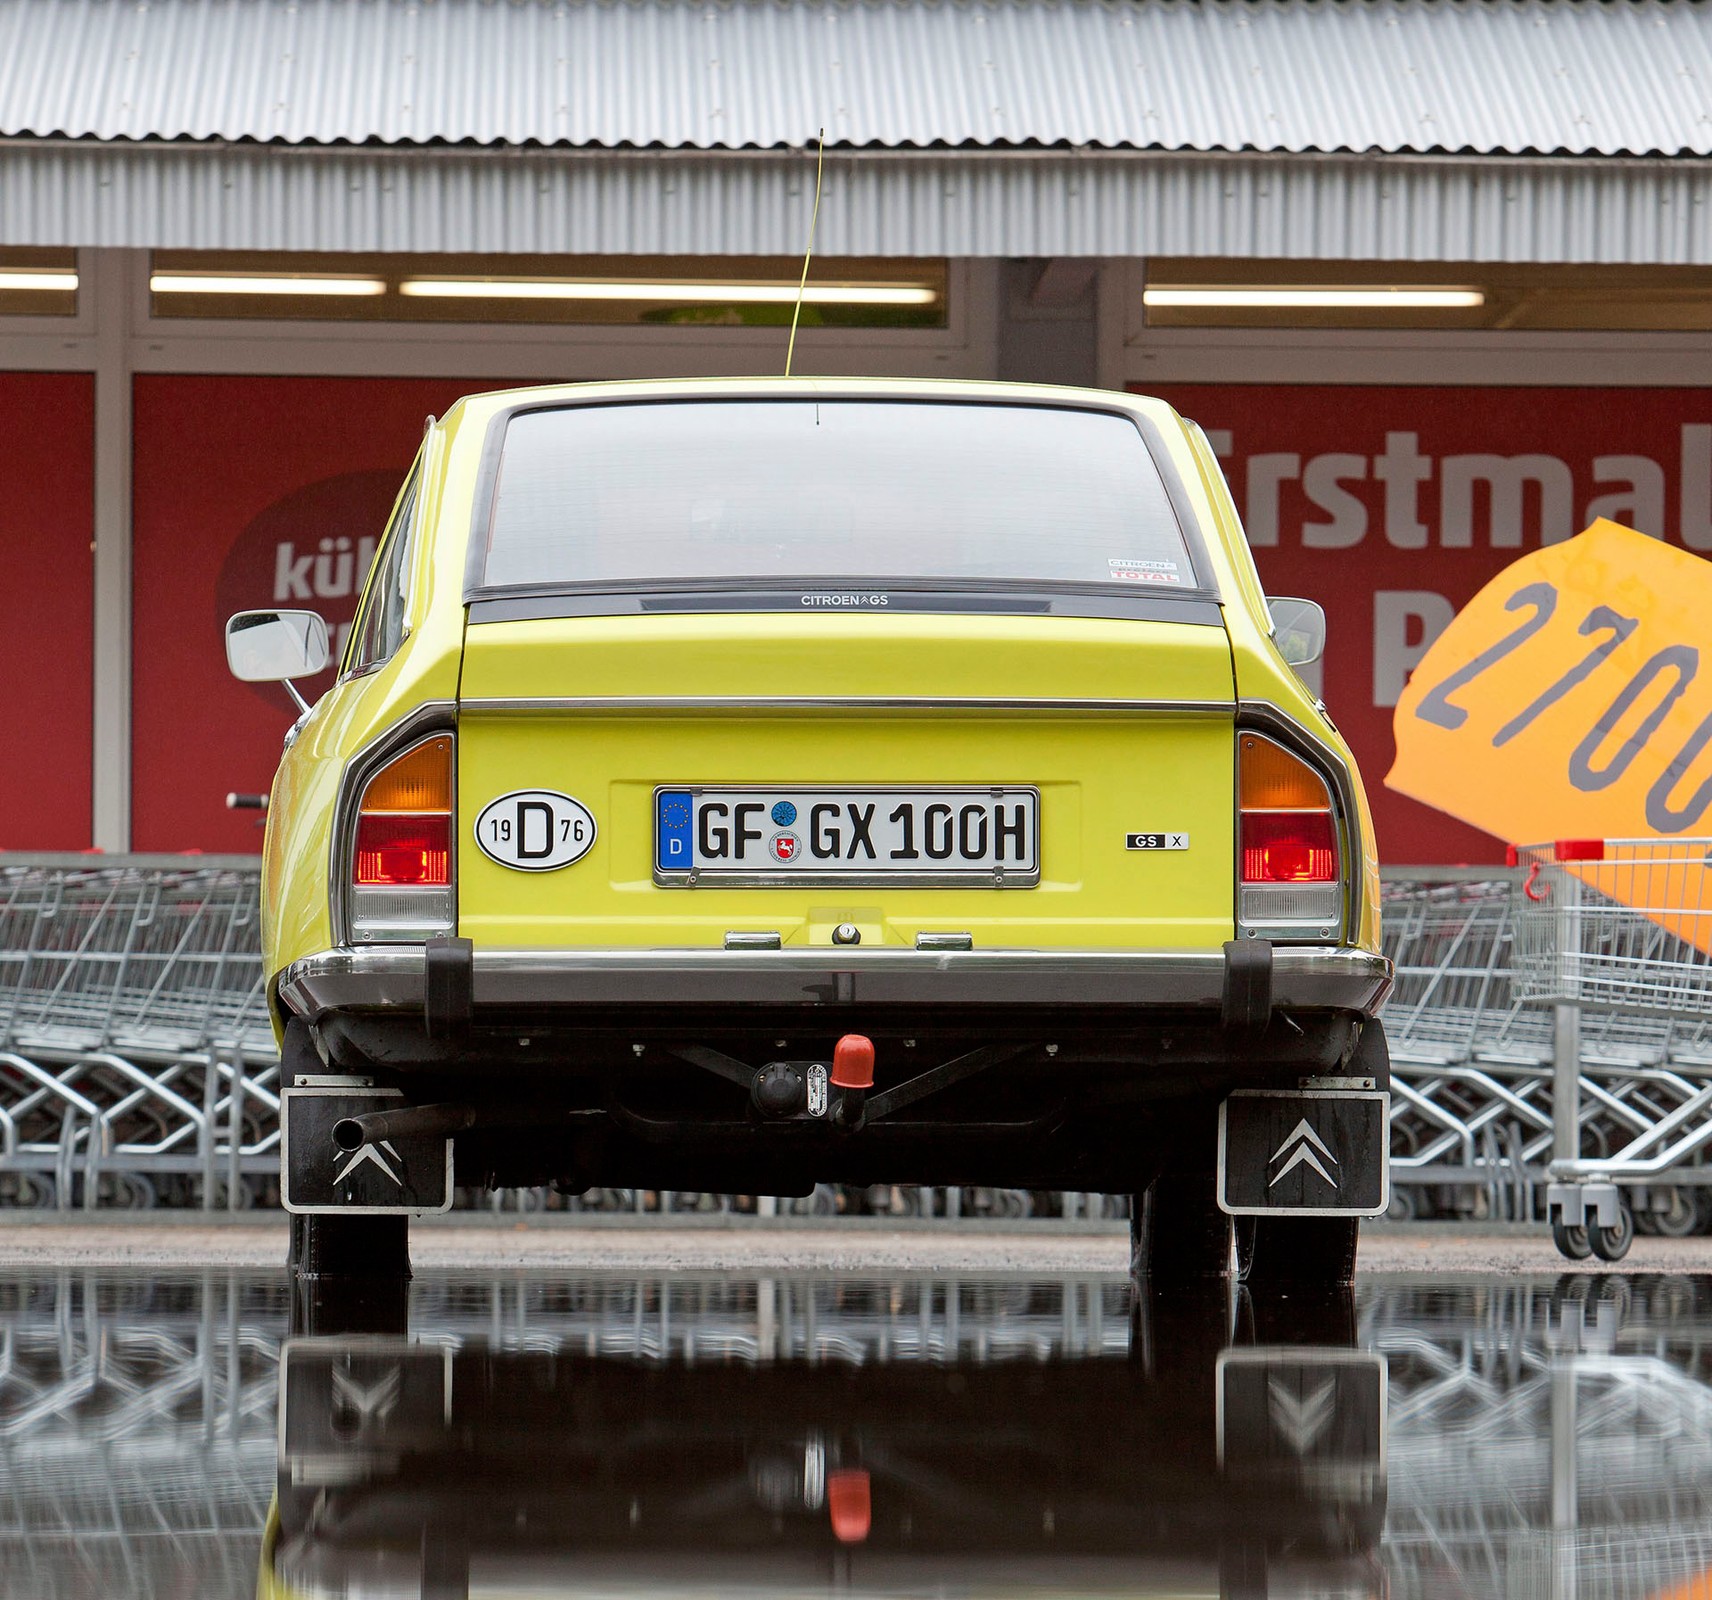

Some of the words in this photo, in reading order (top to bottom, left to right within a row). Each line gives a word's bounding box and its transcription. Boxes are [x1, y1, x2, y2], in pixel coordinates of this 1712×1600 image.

[1204, 423, 1712, 550] rstmal
[1112, 571, 1178, 581] TOTAL
[800, 595, 860, 606] CITROEN
[869, 595, 889, 606] GS
[490, 819, 511, 842] 19
[517, 801, 554, 859] D
[560, 819, 584, 842] 76
[699, 803, 765, 860] GF
[669, 838, 683, 855] D
[1135, 835, 1157, 847] GS
[1172, 835, 1182, 847] X
